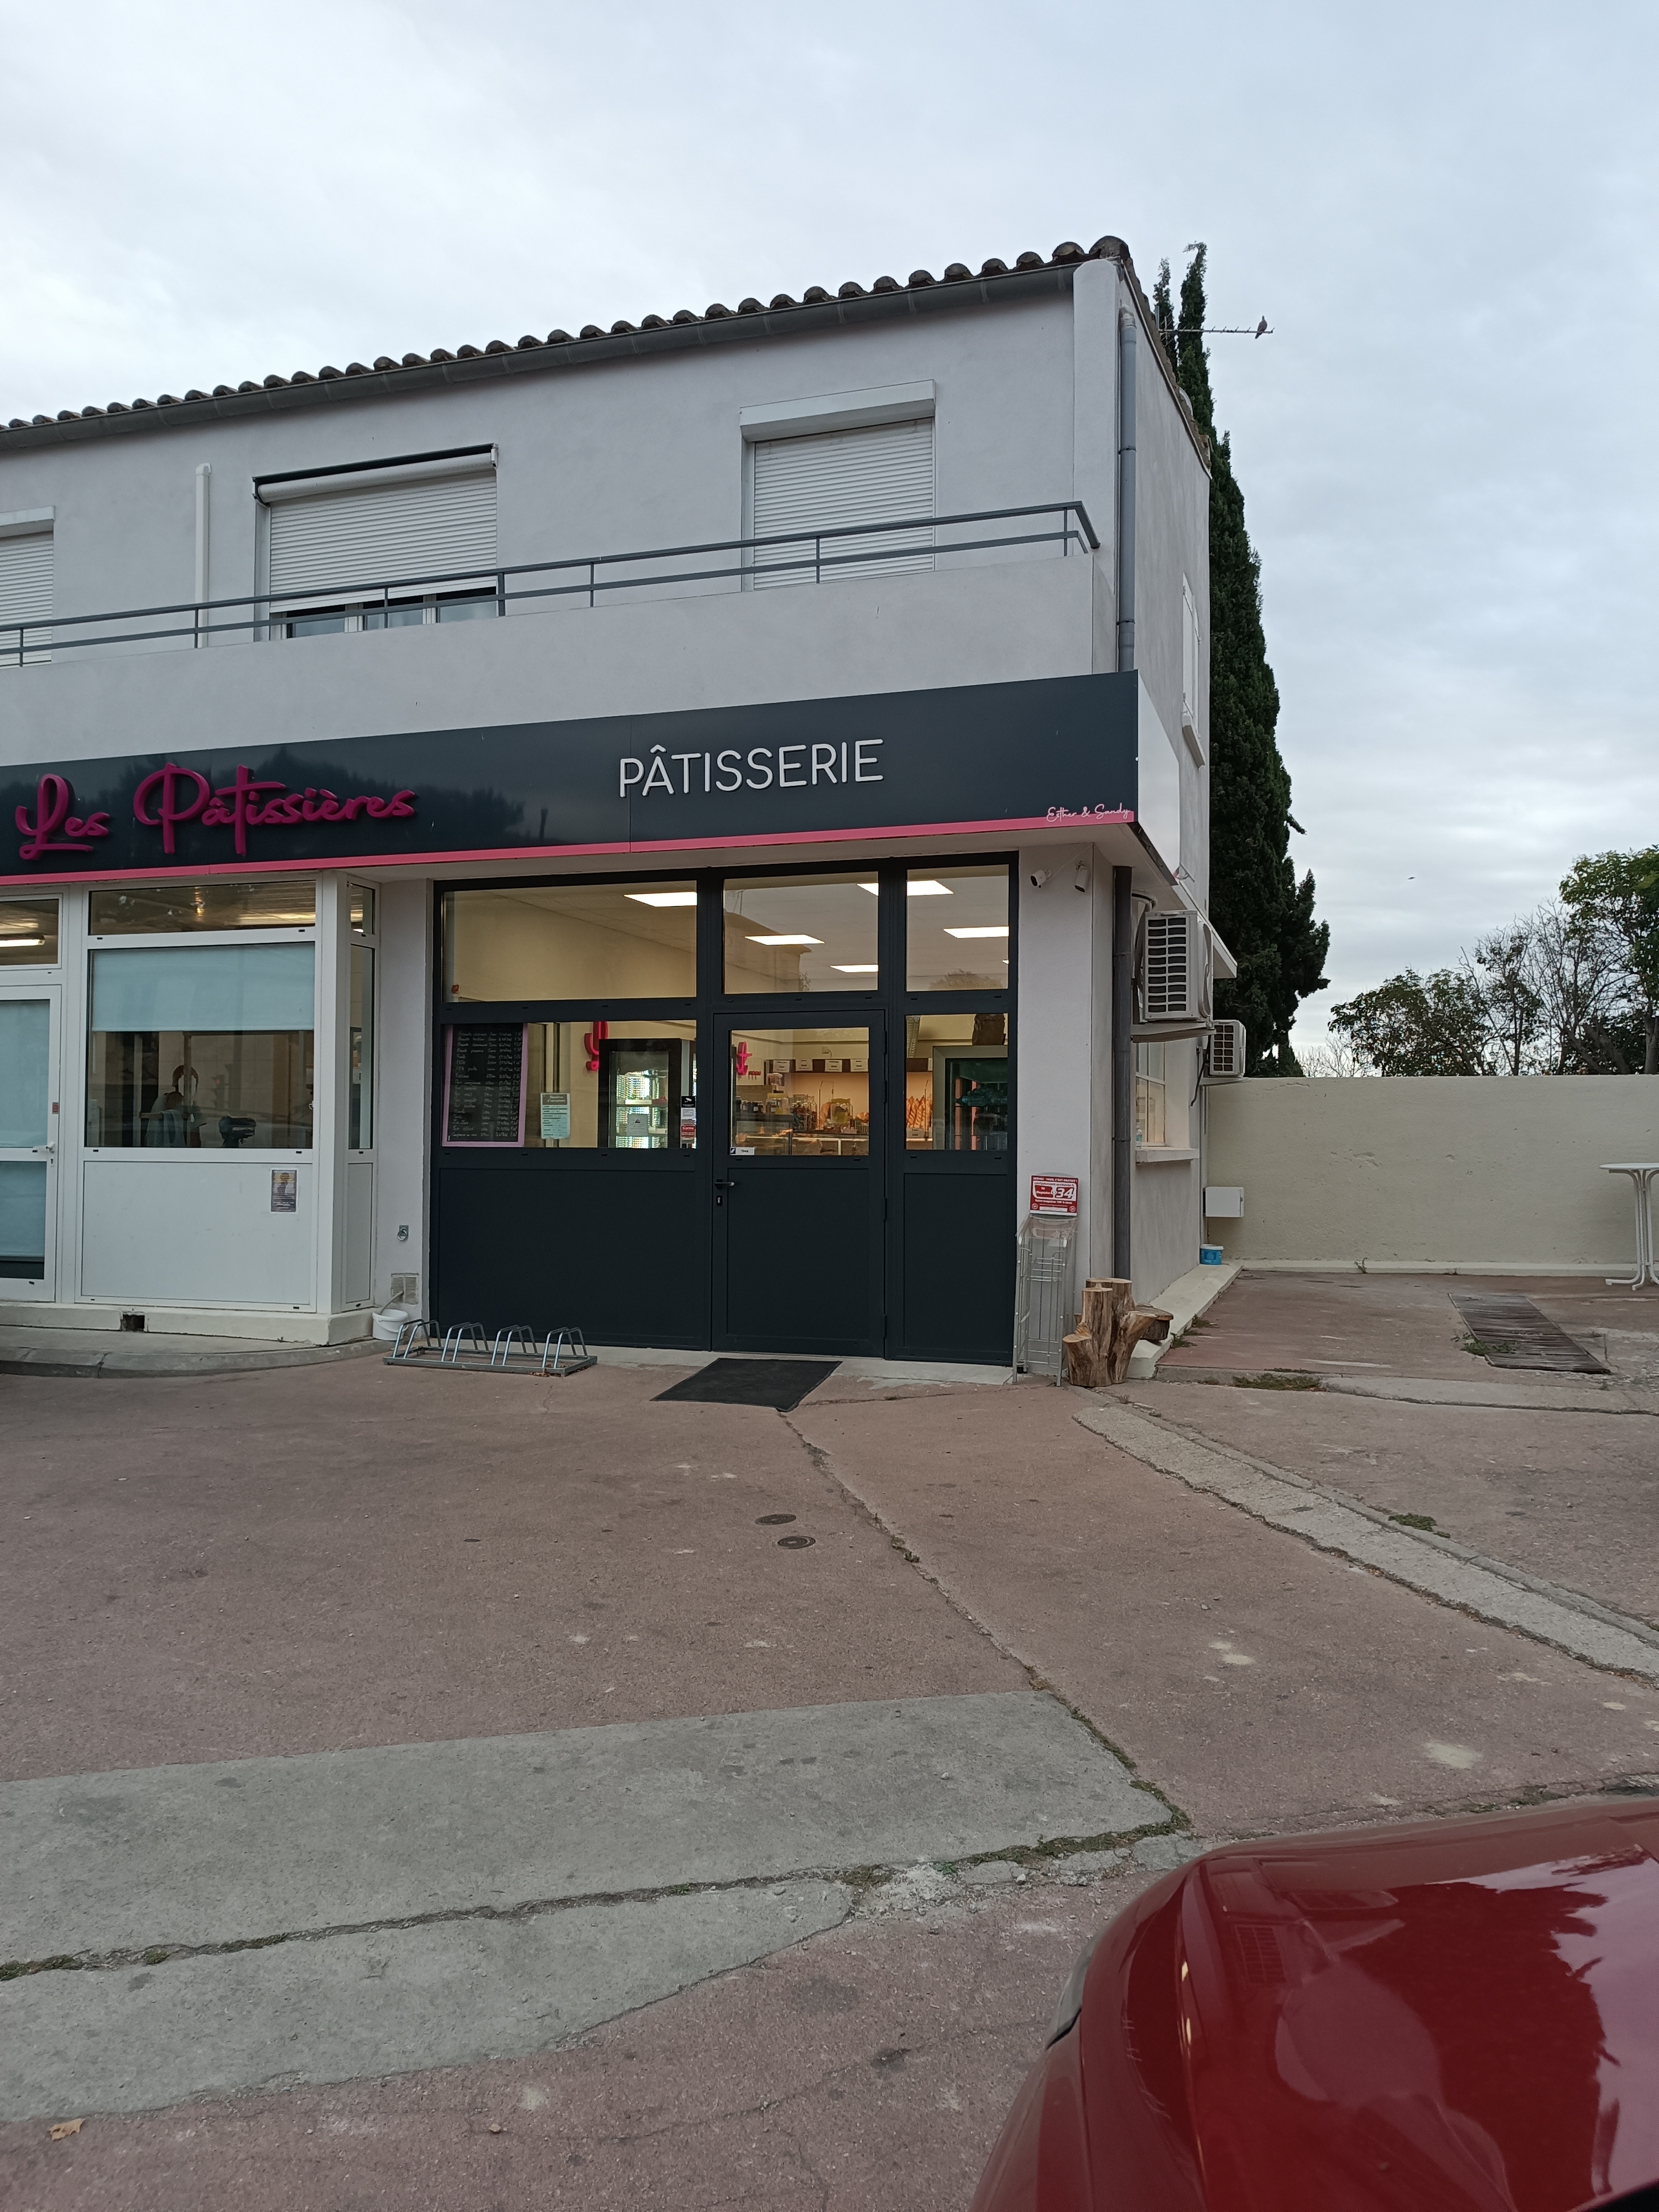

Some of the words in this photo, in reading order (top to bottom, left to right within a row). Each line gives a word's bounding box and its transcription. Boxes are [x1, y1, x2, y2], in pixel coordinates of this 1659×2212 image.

[619, 744, 885, 798] PÂTISSERIE
[15, 774, 111, 860] Les
[133, 763, 416, 855] Pâtissières
[1046, 806, 1077, 822] Esther
[1081, 806, 1091, 817] &
[1094, 802, 1131, 820] Sandy
[1055, 1188, 1074, 1198] 34
